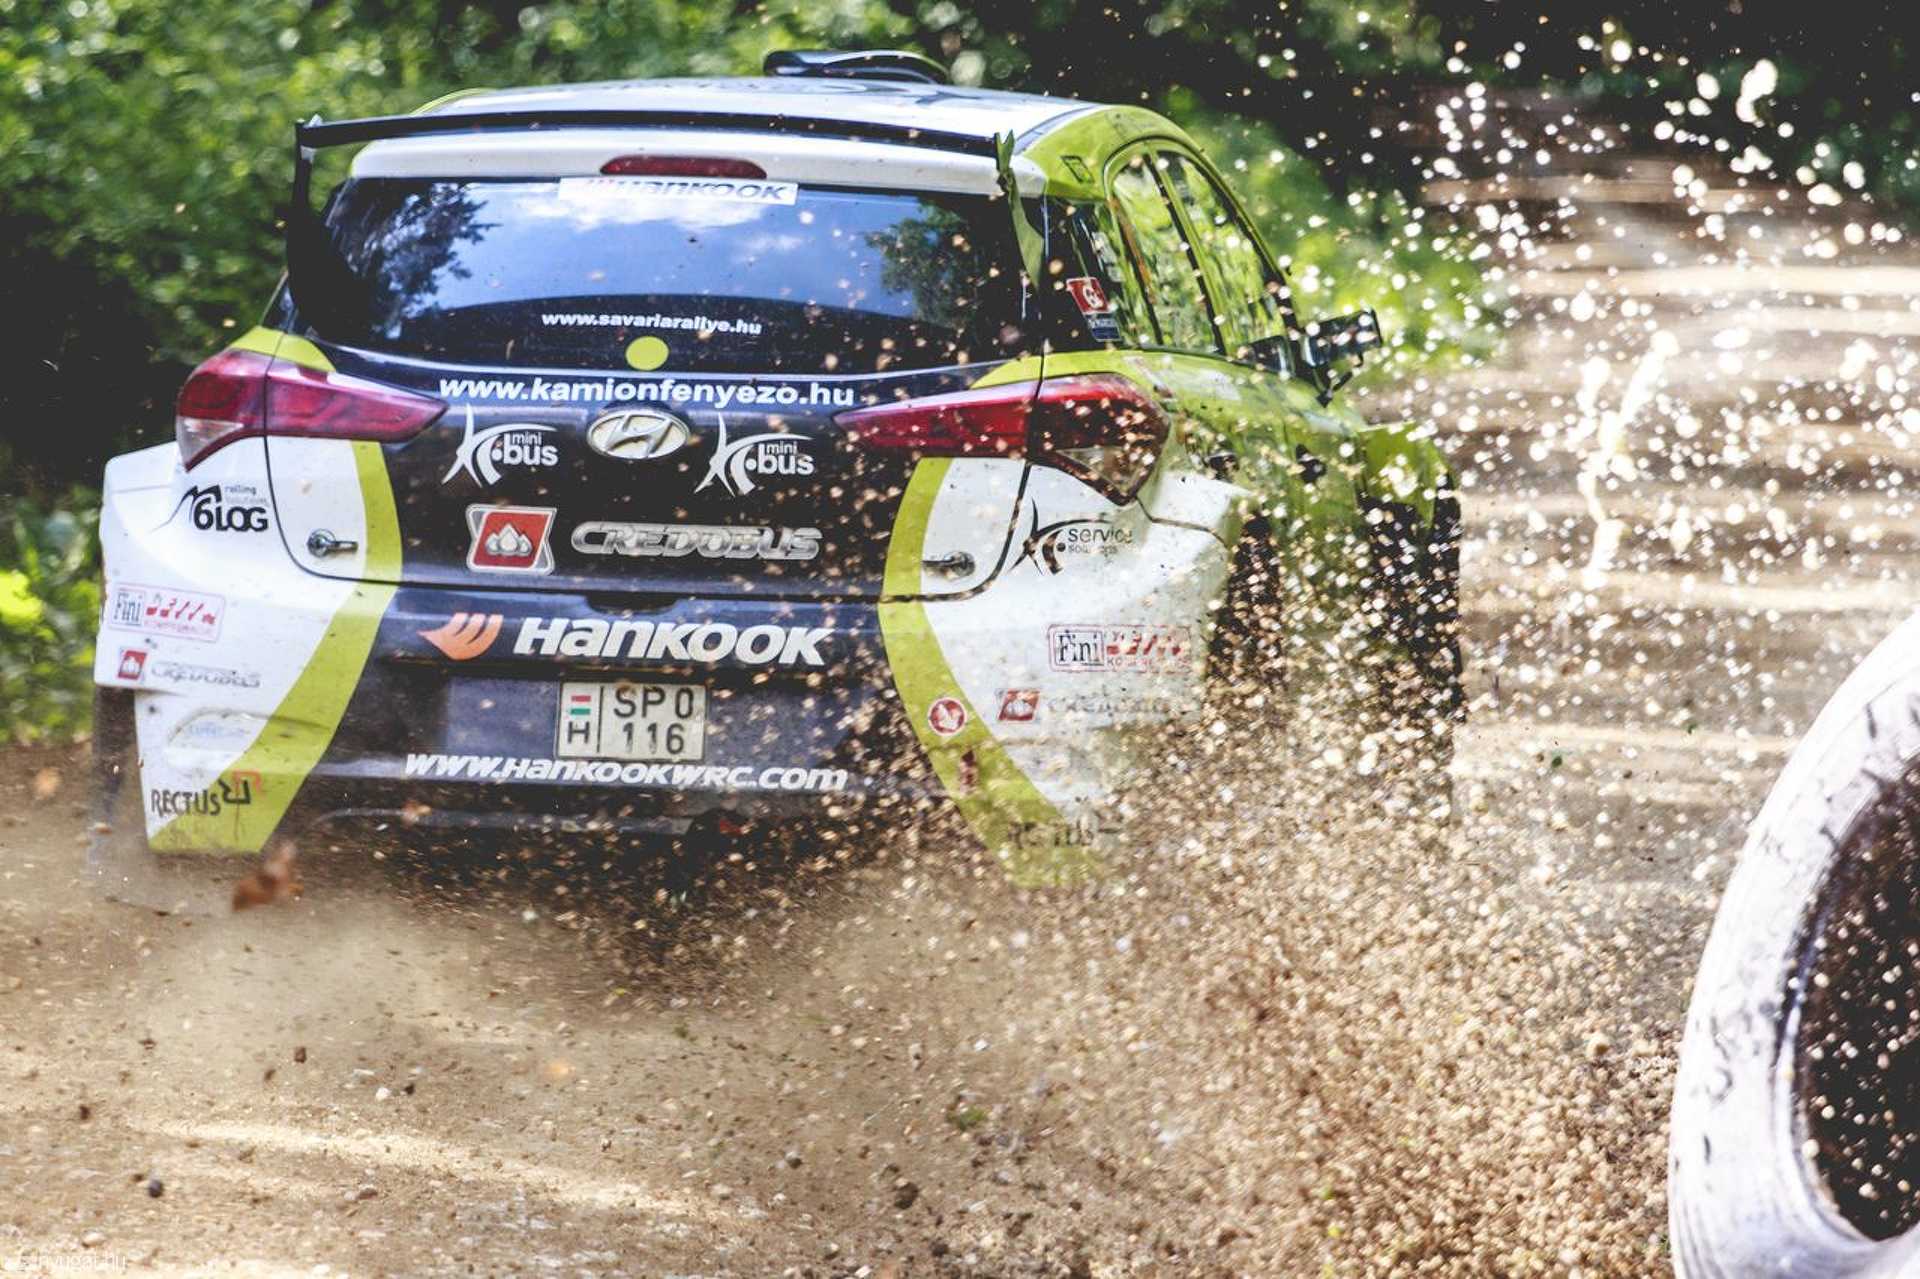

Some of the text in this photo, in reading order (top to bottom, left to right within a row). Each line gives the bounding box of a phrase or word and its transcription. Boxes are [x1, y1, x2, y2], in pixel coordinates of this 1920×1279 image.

[541, 312, 762, 335] www.savariarallye.hu
[439, 378, 854, 409] www.kamionfenyezo.hu
[512, 431, 543, 445] mini
[766, 440, 798, 456] mini
[1057, 632, 1101, 663] Fini
[567, 721, 590, 744] H
[623, 723, 685, 754] 116
[150, 787, 222, 818] RECTUS
